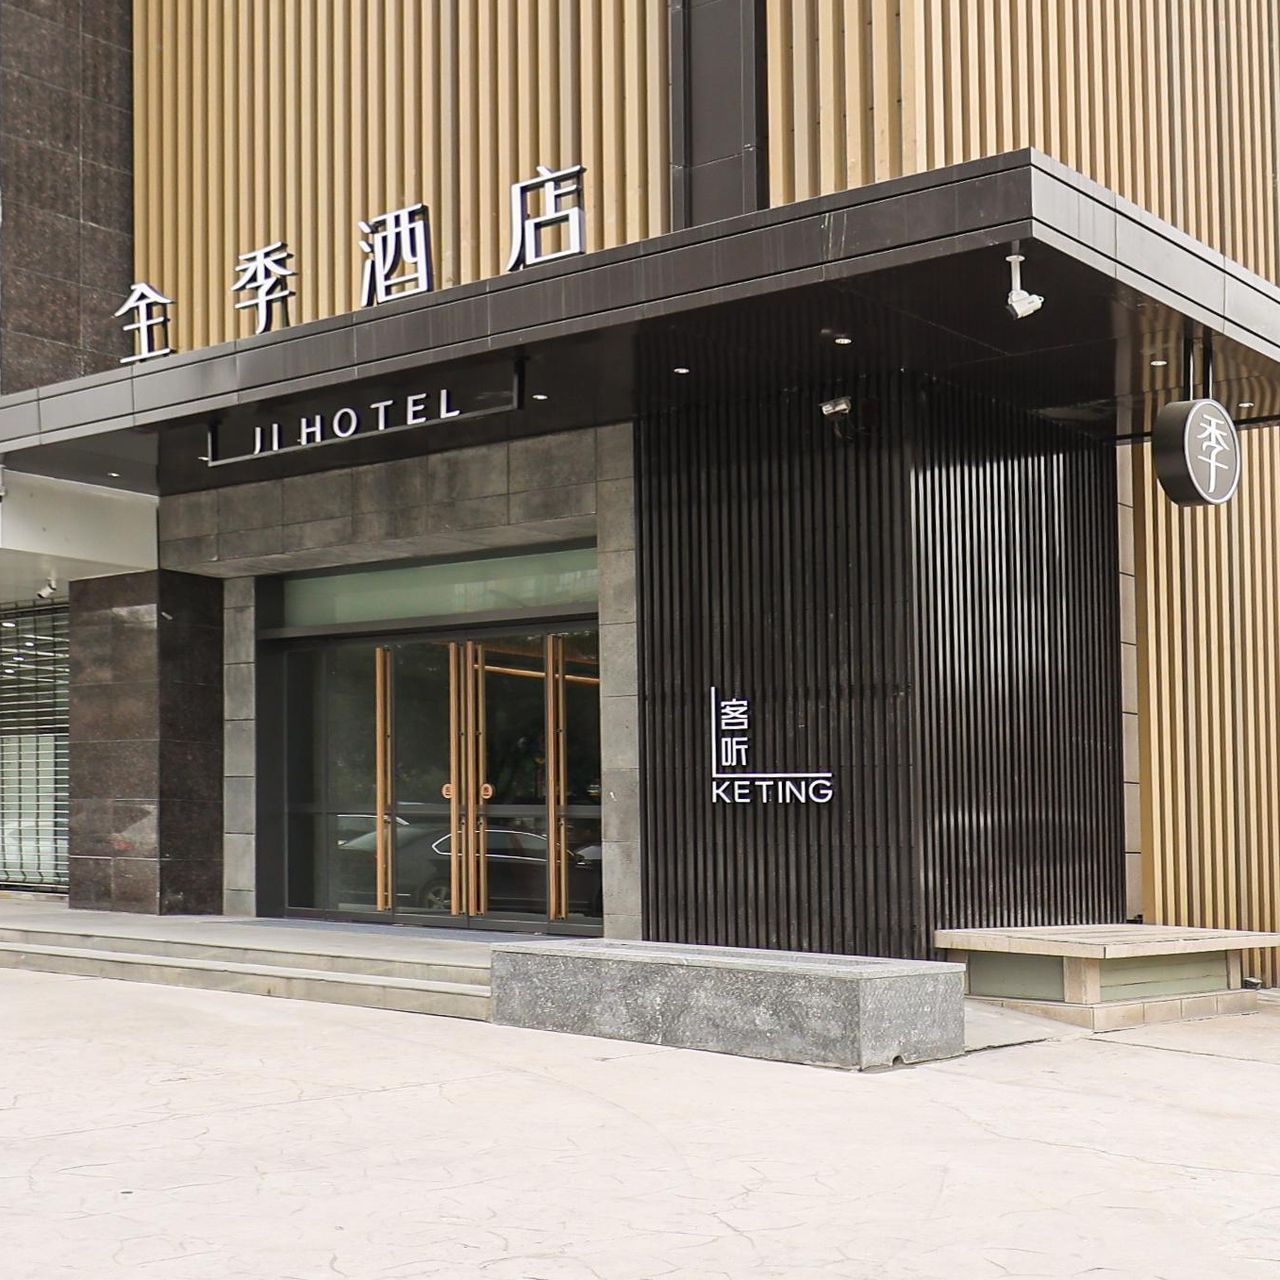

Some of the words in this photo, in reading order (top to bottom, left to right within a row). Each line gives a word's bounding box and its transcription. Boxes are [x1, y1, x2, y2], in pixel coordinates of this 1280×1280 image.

[114, 165, 586, 365] 全季酒店
[253, 423, 279, 455] JI
[300, 389, 461, 446] HOTEL
[720, 699, 749, 766] 客听
[711, 779, 833, 804] KETING
